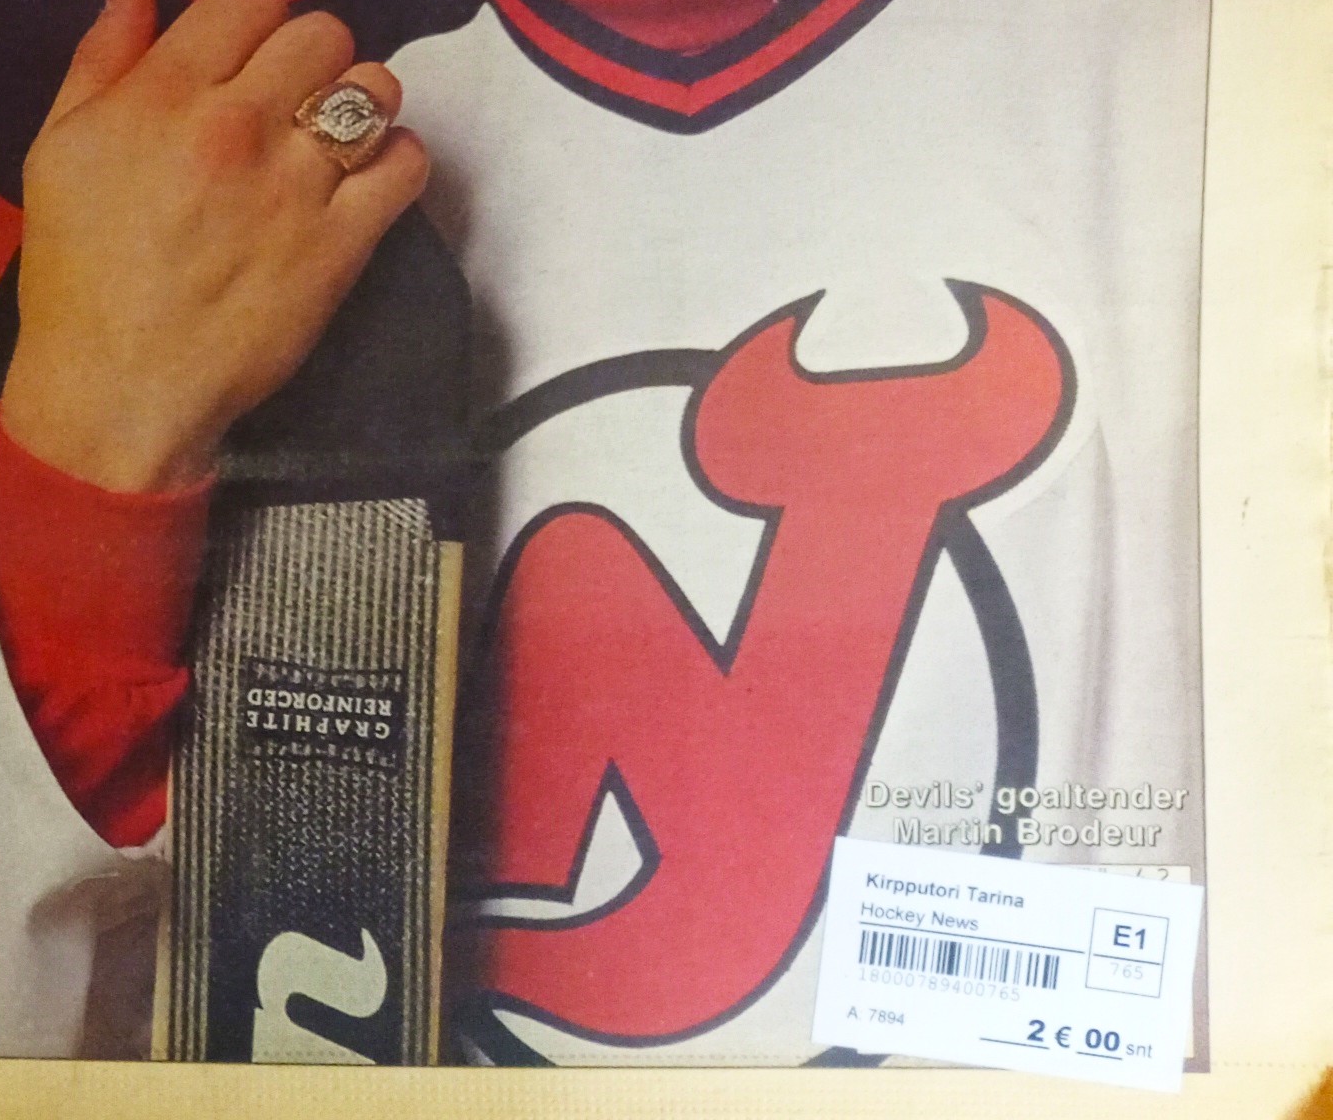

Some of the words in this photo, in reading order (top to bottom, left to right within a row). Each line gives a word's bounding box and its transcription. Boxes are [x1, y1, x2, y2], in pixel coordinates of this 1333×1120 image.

[246, 687, 393, 718] REINFORCED
[245, 708, 391, 740] GRAPHITE
[865, 780, 985, 810] Devils'
[997, 783, 1189, 813] goaltender
[892, 818, 1003, 846] Martin
[1017, 819, 1162, 847] Brodeur
[866, 873, 961, 900] Kirpputori
[967, 885, 1025, 909] Tarina
[860, 902, 925, 927] Hockey
[931, 911, 980, 932] News
[1113, 924, 1147, 951] E1
[1109, 961, 1145, 981] 765
[868, 1008, 906, 1027] 7894
[1027, 1019, 1046, 1043] 2
[1054, 1025, 1072, 1049] €
[1084, 1028, 1121, 1053] 00
[1125, 1040, 1154, 1059] snt
